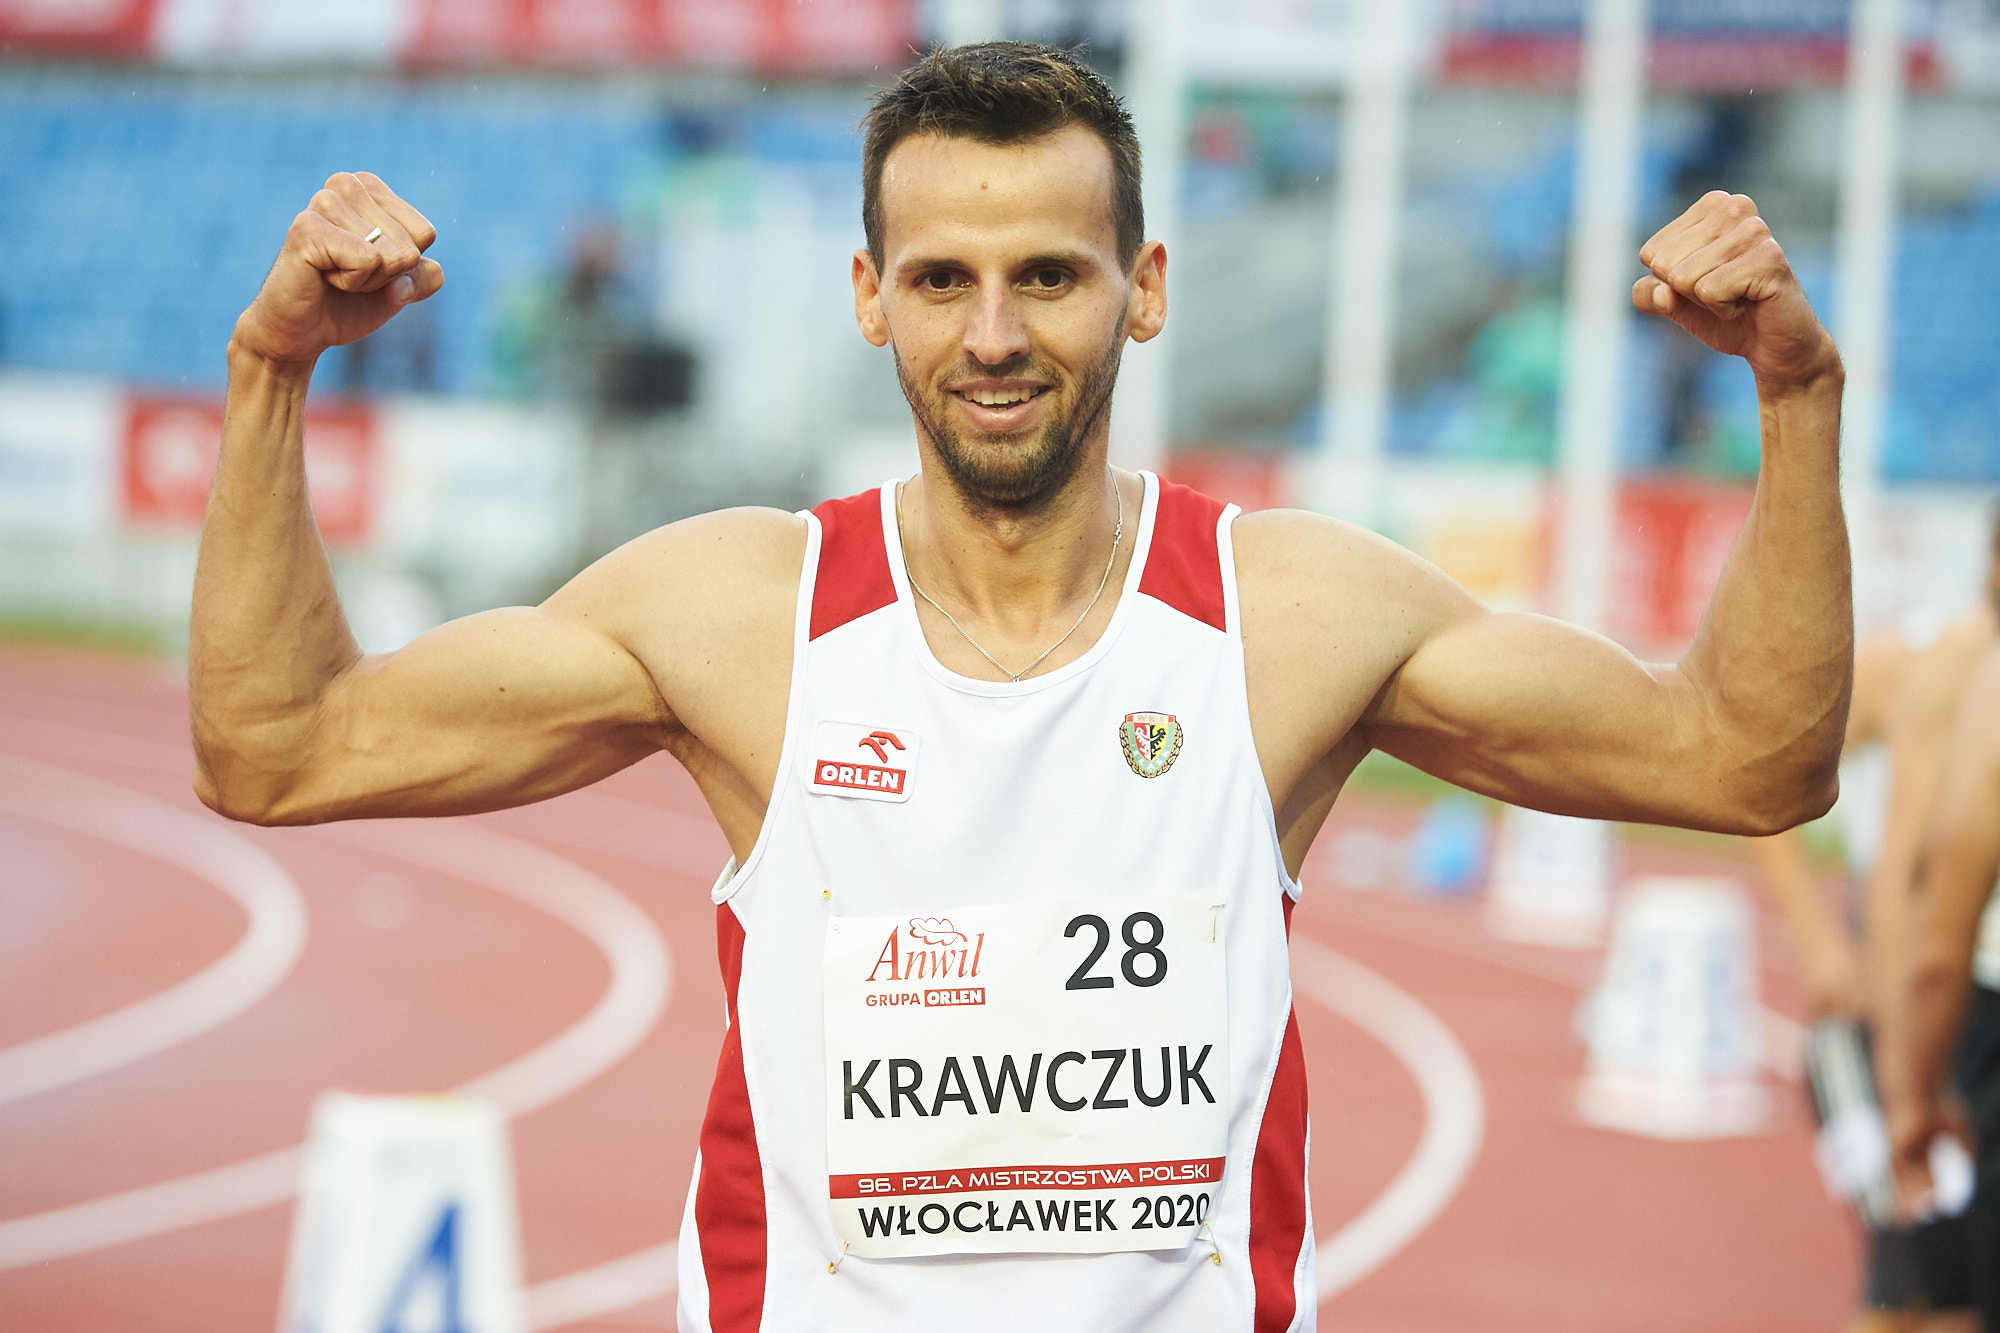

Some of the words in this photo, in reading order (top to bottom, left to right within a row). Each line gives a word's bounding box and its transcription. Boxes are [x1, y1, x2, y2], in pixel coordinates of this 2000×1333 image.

[821, 764, 899, 789] ORLEN
[865, 925, 985, 982] Anwil
[1063, 911, 1168, 990] 28
[866, 993, 921, 1007] GRUPA
[926, 989, 982, 1005] ORLEN
[842, 1044, 1216, 1120] KRAWCZUK
[857, 1178, 896, 1193] 96.
[902, 1174, 963, 1191] PZLA
[968, 1168, 1134, 1188] MISTRZOSTWA
[1139, 1163, 1210, 1182] POLSKI
[857, 1200, 1118, 1238] WŁOCŁAWEK
[1131, 1192, 1210, 1230] 2020
